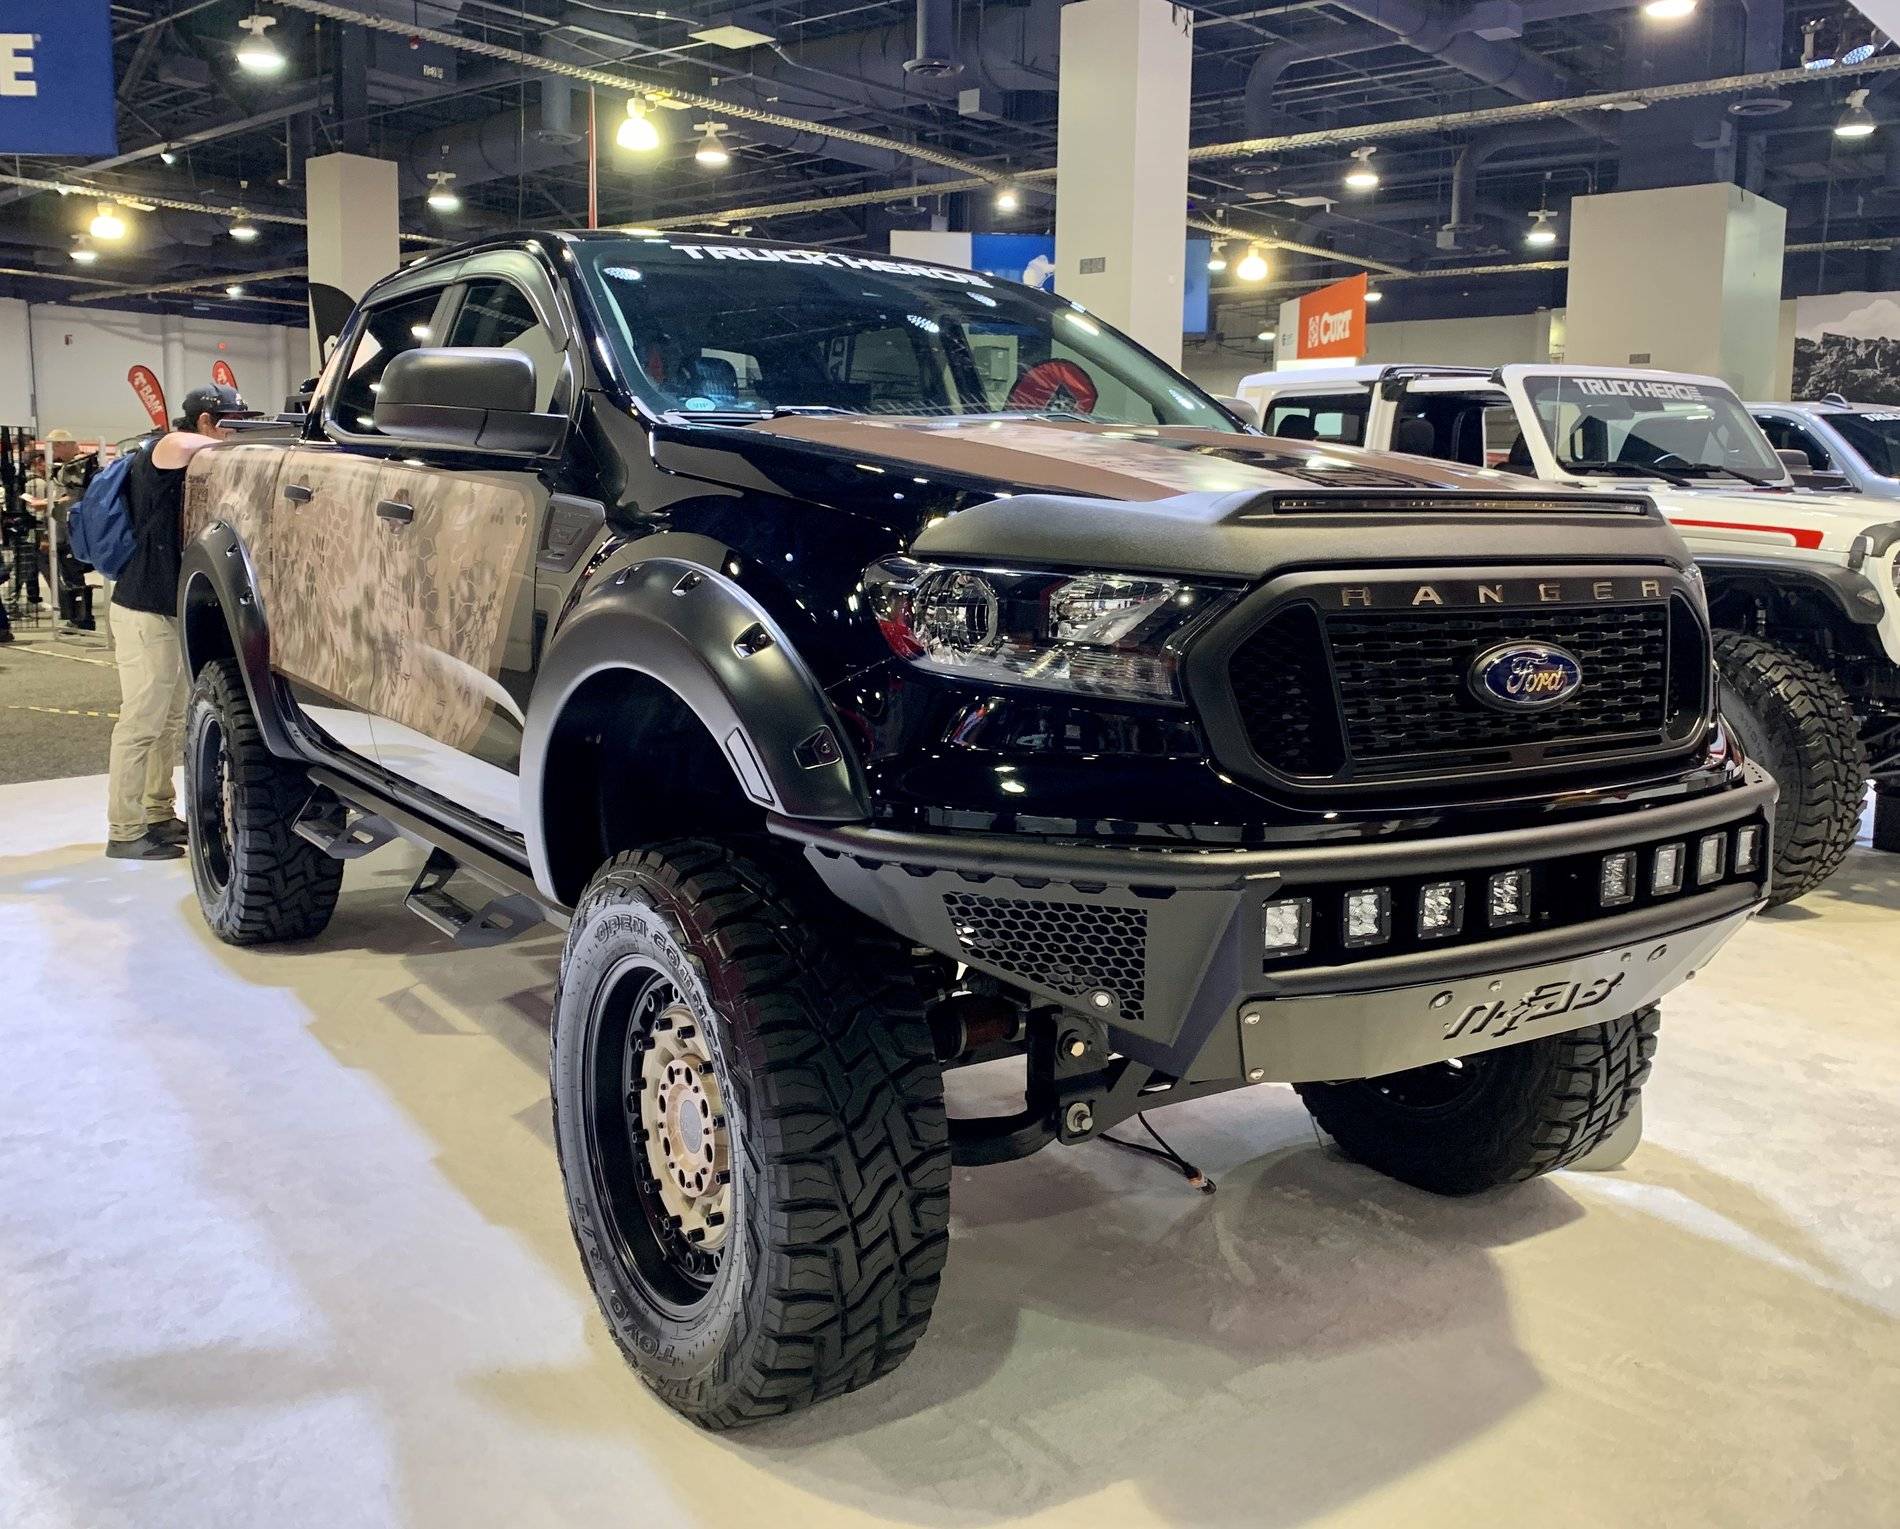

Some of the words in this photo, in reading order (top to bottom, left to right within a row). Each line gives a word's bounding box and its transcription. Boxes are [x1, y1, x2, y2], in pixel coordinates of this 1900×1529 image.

[670, 245, 844, 267] TRUCK
[1572, 379, 1642, 397] TRUCK
[1340, 579, 1661, 607] RANGER
[1506, 649, 1568, 694] Ford
[594, 913, 648, 944] OPEN
[608, 1294, 678, 1368] TOYO
